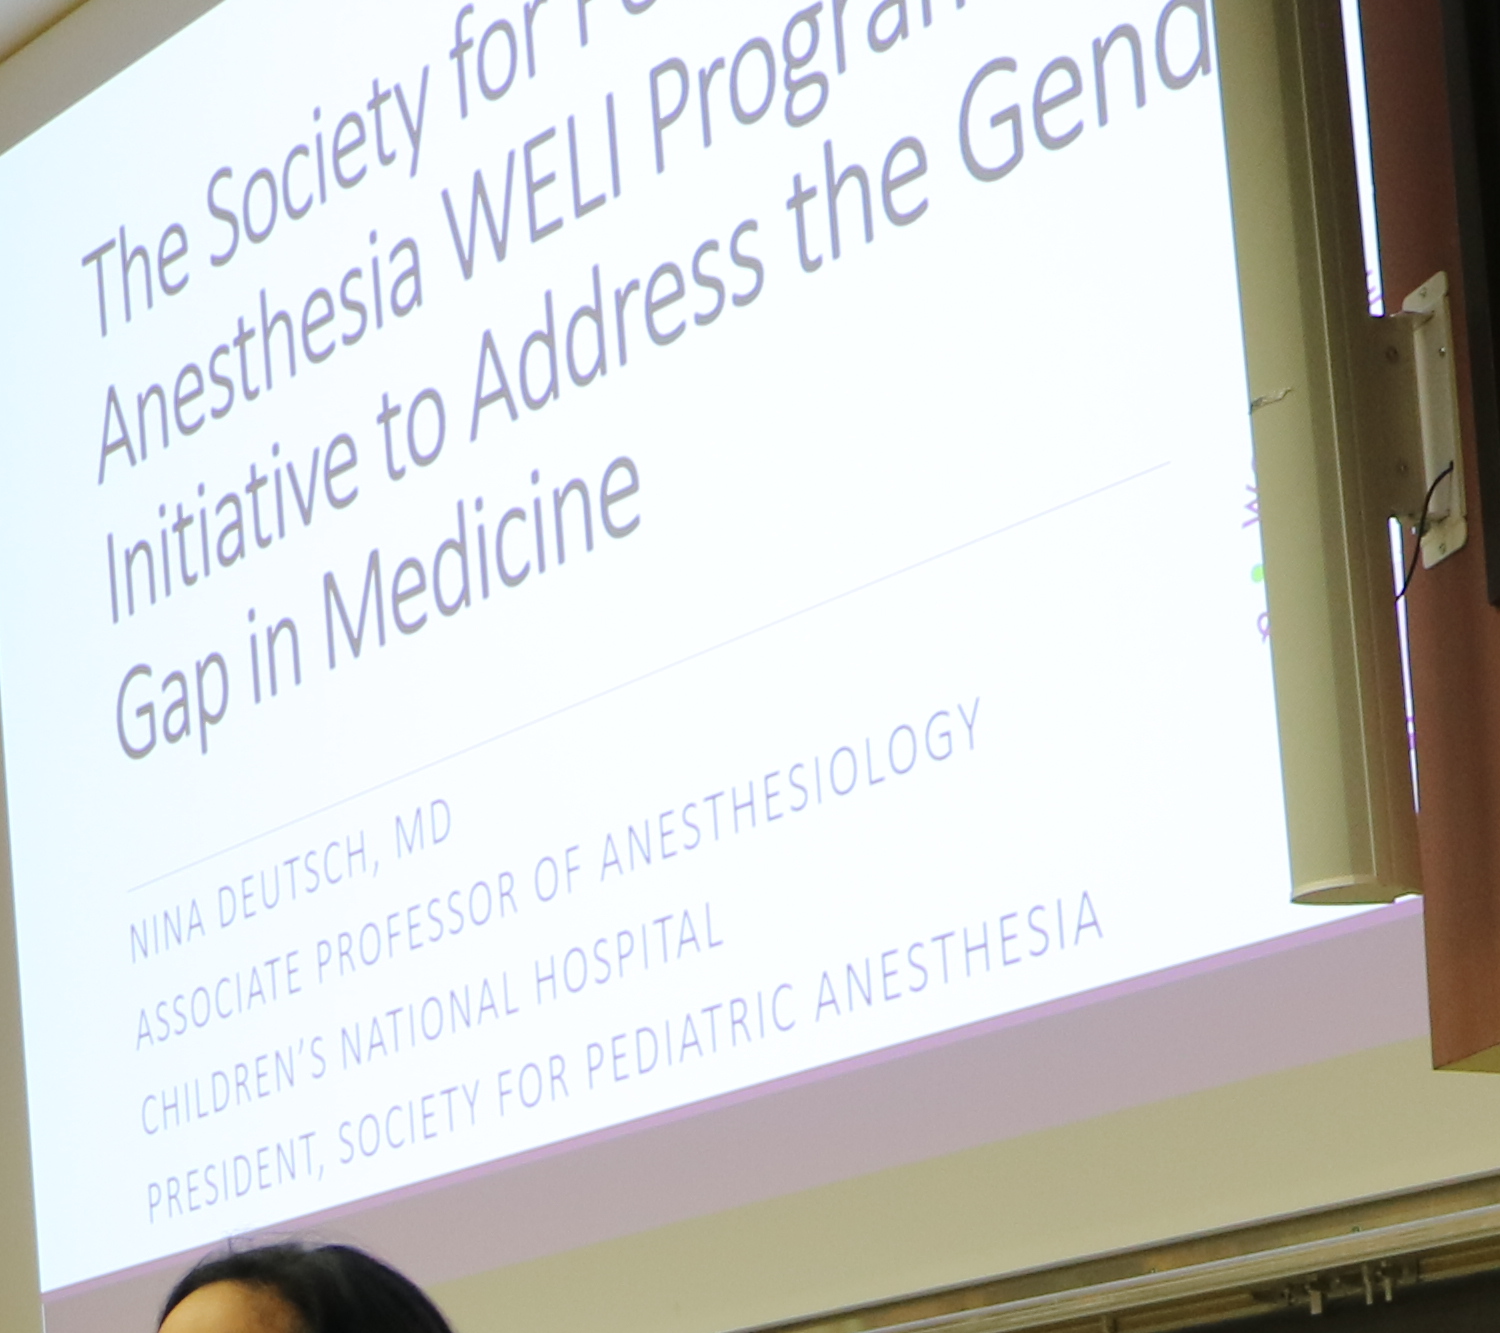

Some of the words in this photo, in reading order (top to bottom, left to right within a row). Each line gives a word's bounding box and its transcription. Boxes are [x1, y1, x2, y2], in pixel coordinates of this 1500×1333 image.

[81, 223, 190, 338] The
[206, 64, 430, 267] Society
[449, 0, 546, 120] for
[97, 229, 424, 486] Anesthesia
[440, 92, 622, 281] WELI
[106, 432, 360, 625] Initiative
[376, 387, 446, 482] to
[470, 218, 765, 443] Address
[785, 135, 929, 273] the
[115, 650, 230, 761] Gap
[247, 606, 302, 706] in
[322, 455, 642, 671] Medicine
[129, 898, 206, 965] NINA
[217, 829, 380, 930] DEUTSCH,
[394, 798, 453, 860] MD
[135, 949, 303, 1052] ASSOCIATE
[316, 869, 519, 985] PROFESSOR
[533, 844, 582, 904] OF
[599, 695, 981, 883] ANESTHESIOLOGY
[340, 970, 521, 1072] NATIONAL
[533, 901, 724, 1006] HOSPITAL
[146, 1129, 325, 1225] PRESIDENT,
[337, 1078, 481, 1166] SOCIETY
[497, 1053, 570, 1118] FOR
[586, 982, 797, 1091] PEDIATRIC
[814, 889, 1104, 1024] ANESTHESIA
